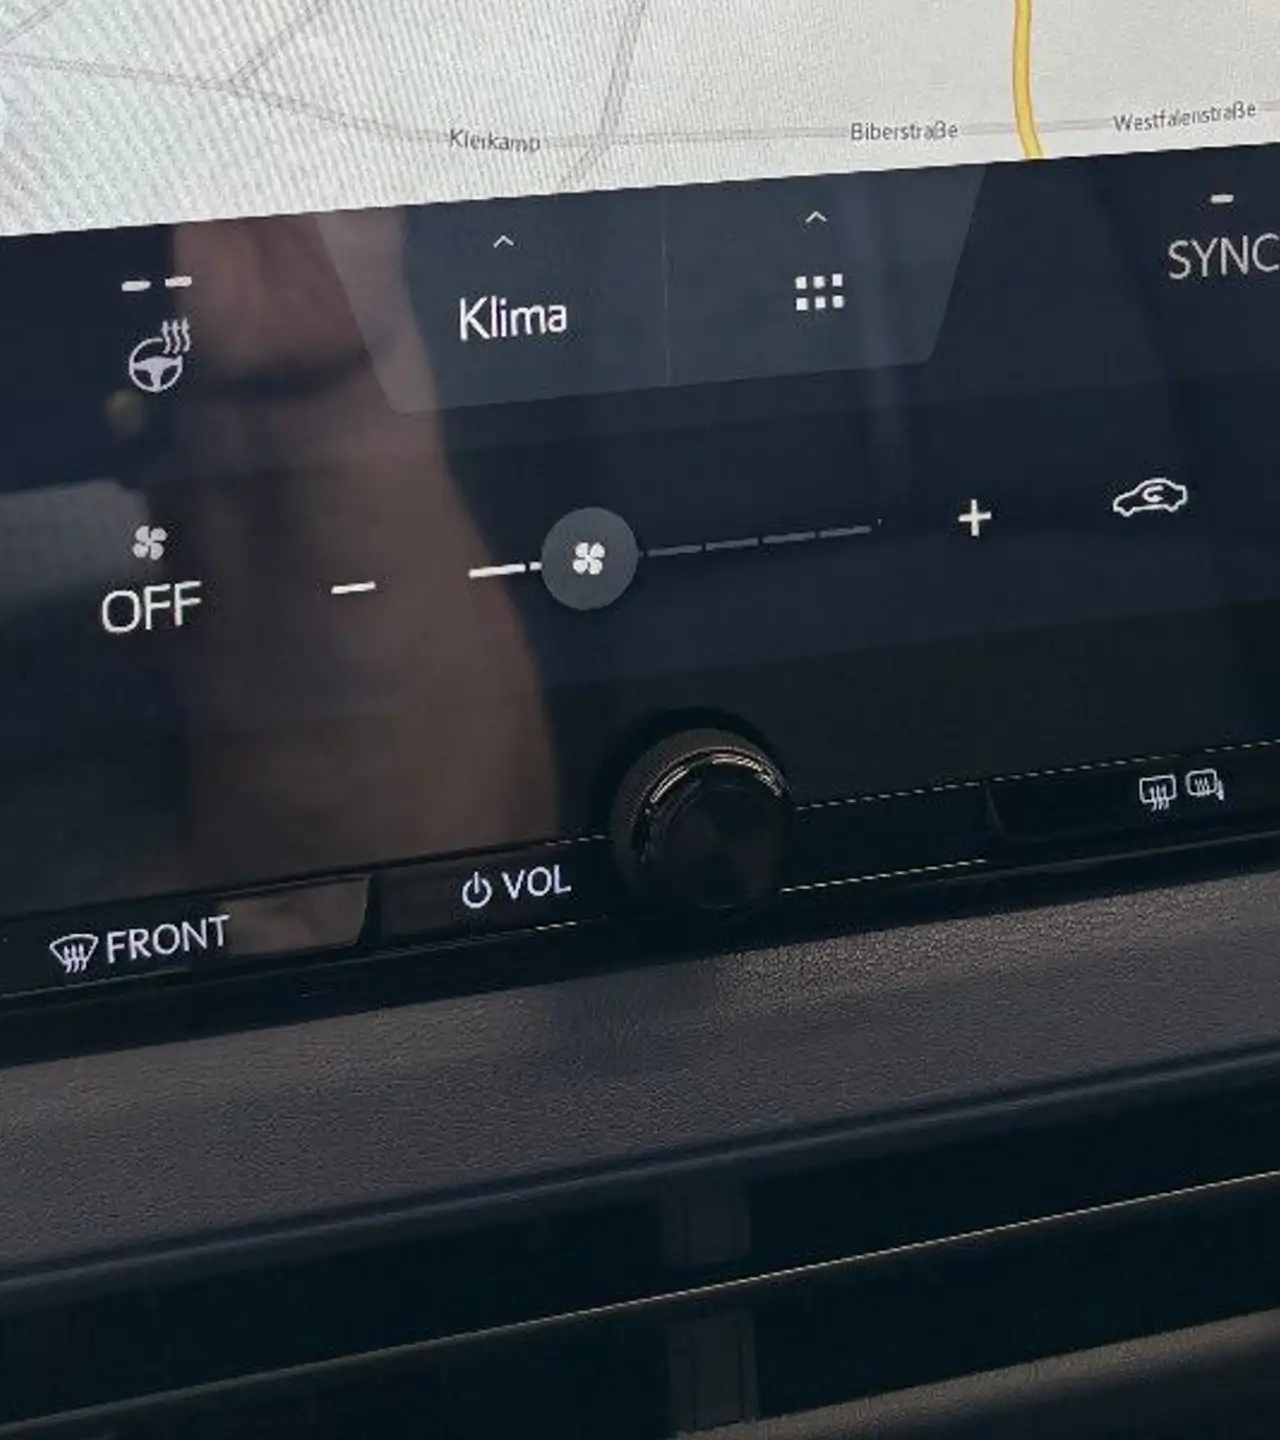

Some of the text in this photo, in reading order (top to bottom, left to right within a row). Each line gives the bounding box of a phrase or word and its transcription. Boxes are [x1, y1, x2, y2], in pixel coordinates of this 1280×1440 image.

[850, 120, 959, 141] Biberstraße
[1113, 100, 1257, 132] Westfalenstraße
[1168, 233, 1280, 279] SYNC
[459, 295, 568, 341] Klima
[101, 580, 202, 634] OFF
[502, 865, 572, 900] VOL
[104, 914, 231, 964] FRONT
